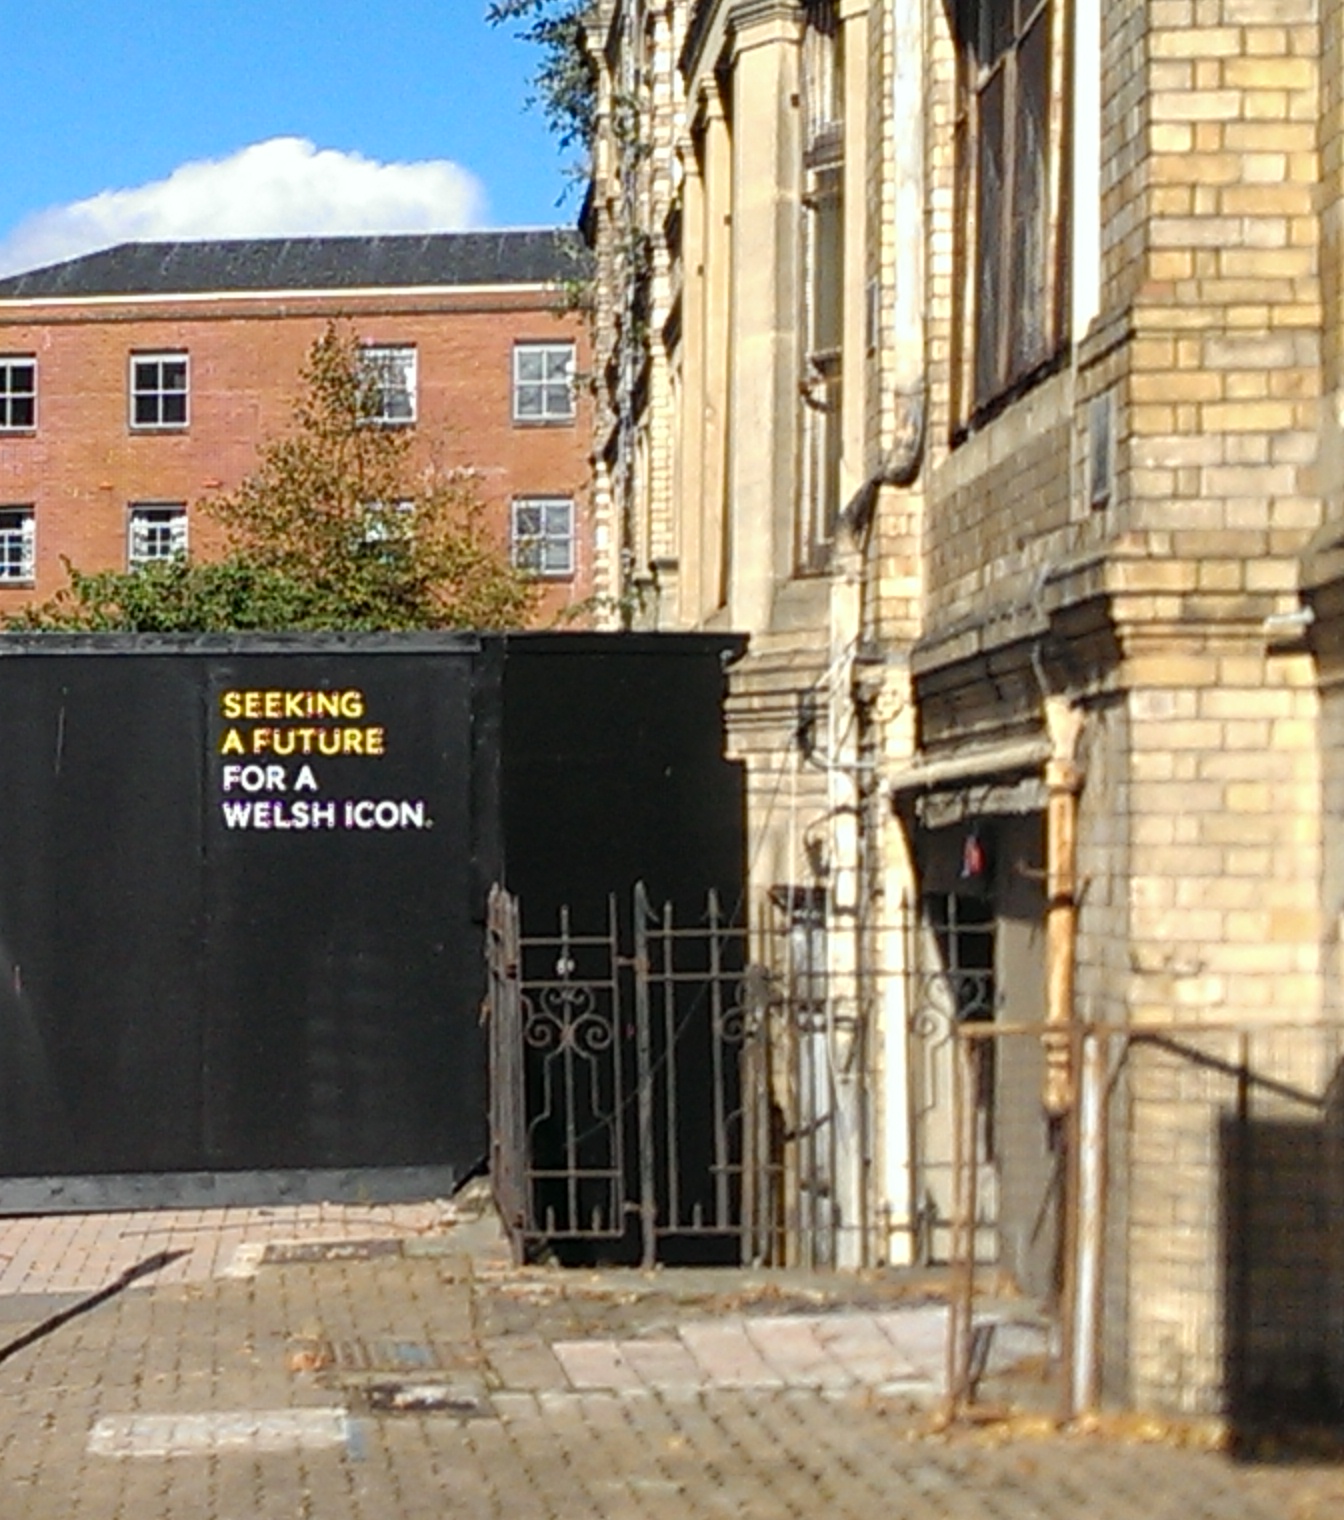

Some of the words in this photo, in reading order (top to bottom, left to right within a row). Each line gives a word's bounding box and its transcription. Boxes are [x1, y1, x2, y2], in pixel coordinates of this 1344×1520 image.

[222, 689, 365, 719] SEEKING
[220, 727, 246, 756] A
[252, 727, 386, 756] FUTURE
[222, 764, 287, 793] FOR
[293, 764, 318, 792] A
[221, 800, 336, 829] WELSH
[344, 800, 434, 829] ICON.
